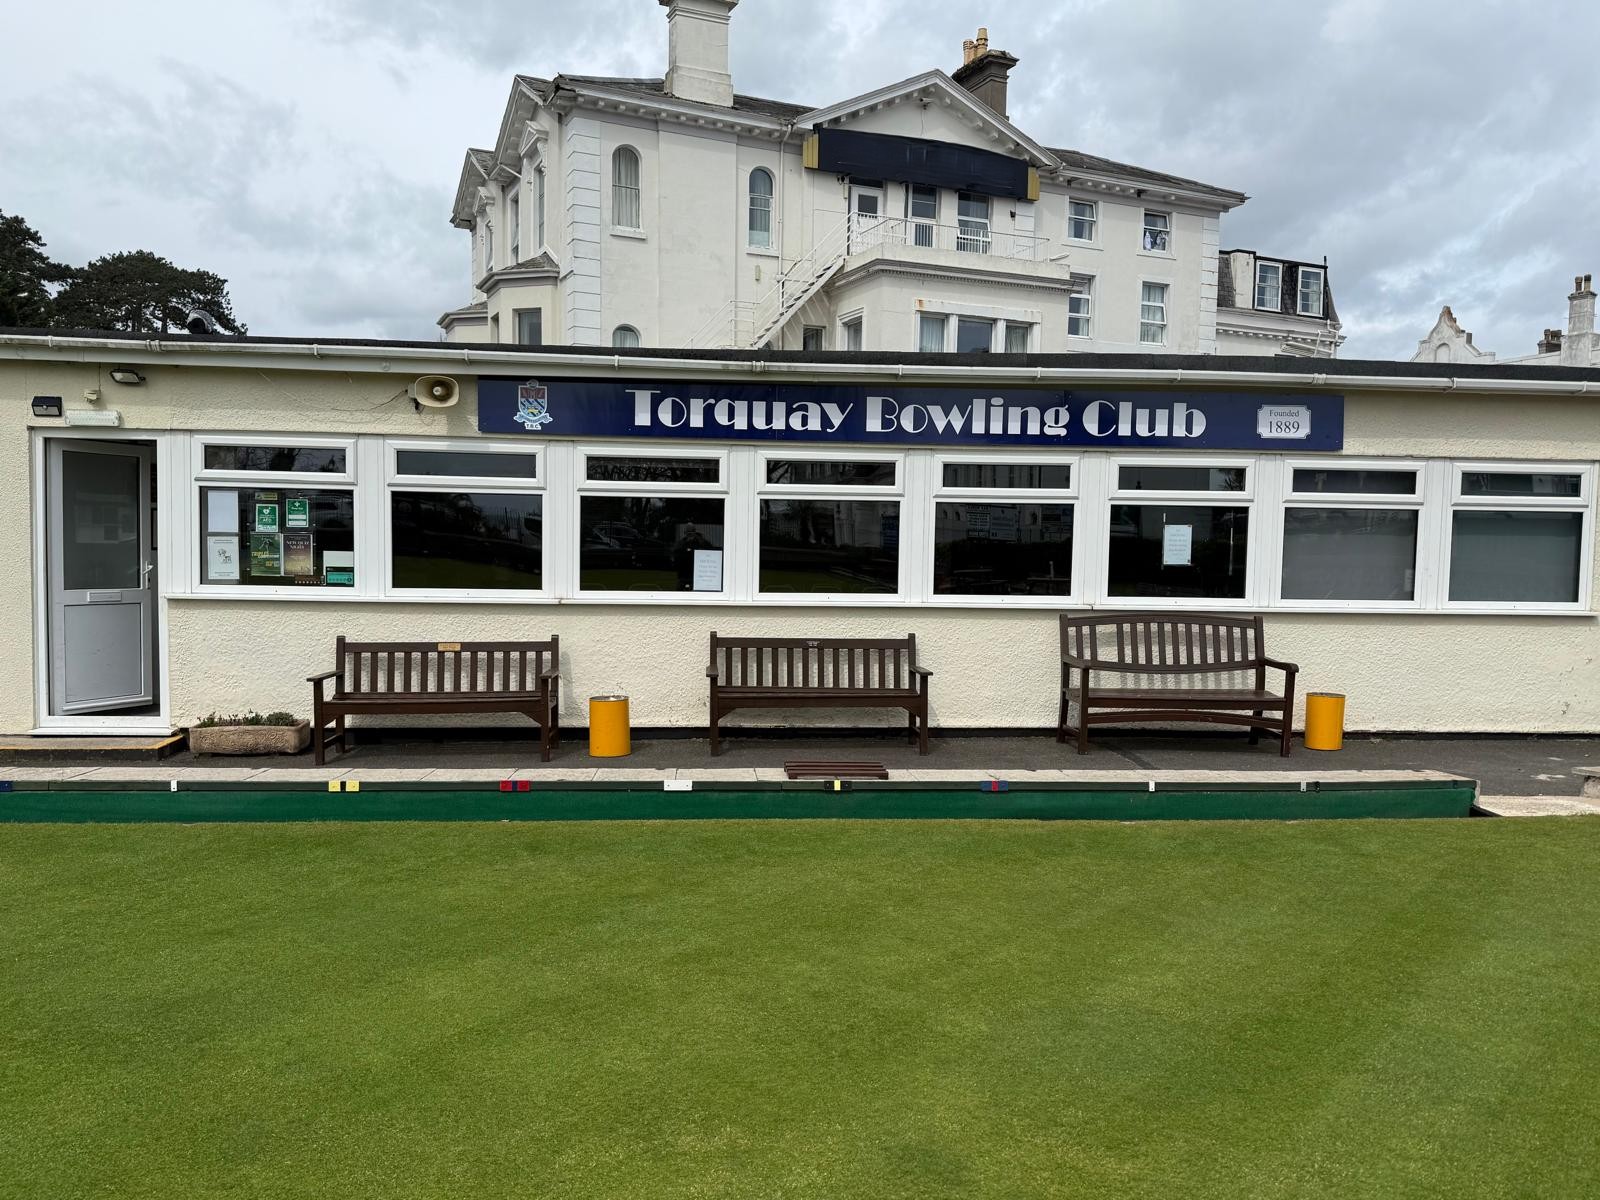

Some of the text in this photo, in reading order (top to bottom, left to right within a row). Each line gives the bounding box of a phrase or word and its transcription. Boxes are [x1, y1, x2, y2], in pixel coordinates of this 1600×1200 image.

[625, 389, 1207, 438] Torquay Bowling Club
[1269, 410, 1300, 418] Founded
[1268, 420, 1300, 434] 1889
